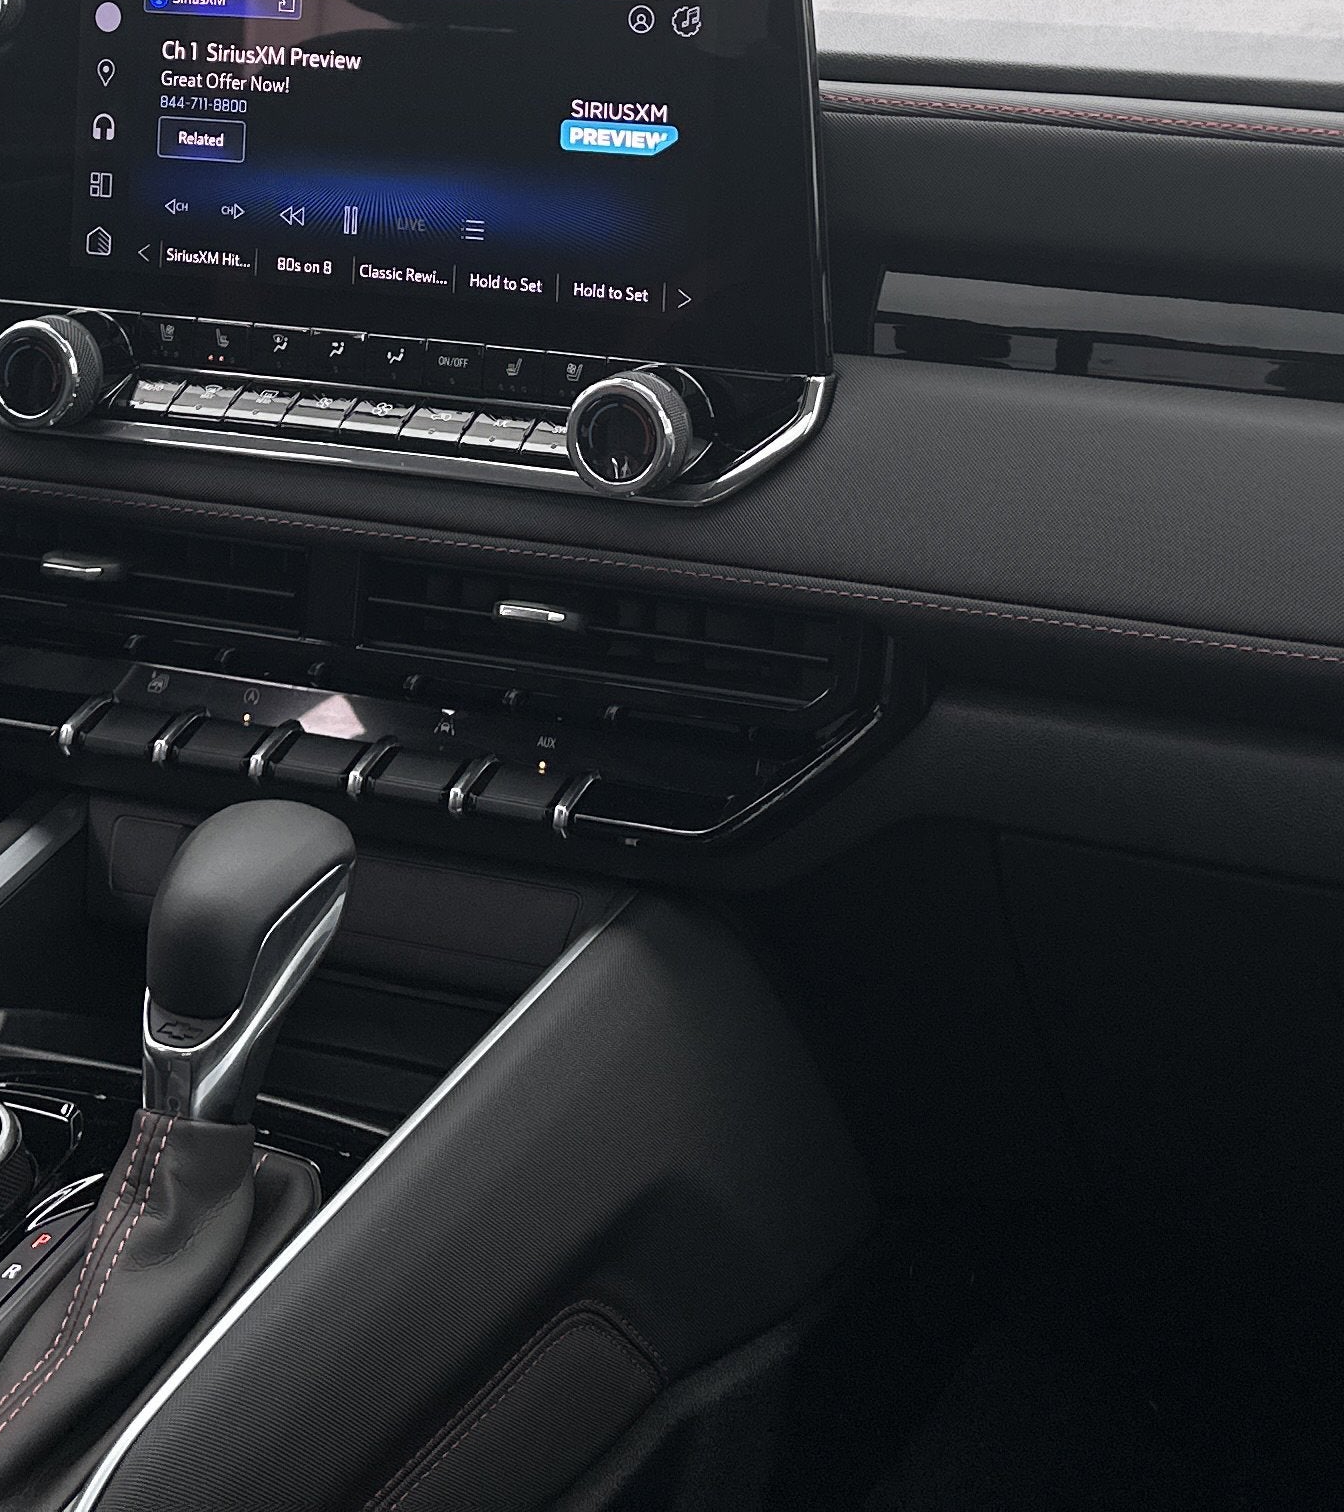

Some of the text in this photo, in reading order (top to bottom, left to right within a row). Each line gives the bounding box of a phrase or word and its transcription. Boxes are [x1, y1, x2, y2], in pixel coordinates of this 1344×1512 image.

[162, 40, 362, 70] Ch 1 SiriusXM Preview
[161, 71, 290, 94] Great Offer Now!
[160, 95, 247, 113] 844-711-8800
[570, 99, 668, 123] SIRIUSXM
[178, 130, 224, 148] Related
[569, 126, 668, 150] PREVIEW
[176, 202, 189, 212] CH
[221, 205, 234, 216] CH
[397, 218, 426, 232] LIVE
[166, 247, 251, 268] SiriusXM Hit...
[277, 257, 333, 275] 80s on 8
[359, 264, 448, 285] Classic Rewi...
[469, 273, 543, 294] Hold to Set
[573, 282, 649, 303] Hold to Set
[438, 355, 469, 369] ON/OFF
[536, 735, 556, 750] AUX
[32, 1233, 52, 1249] P
[1, 1263, 22, 1279] R
